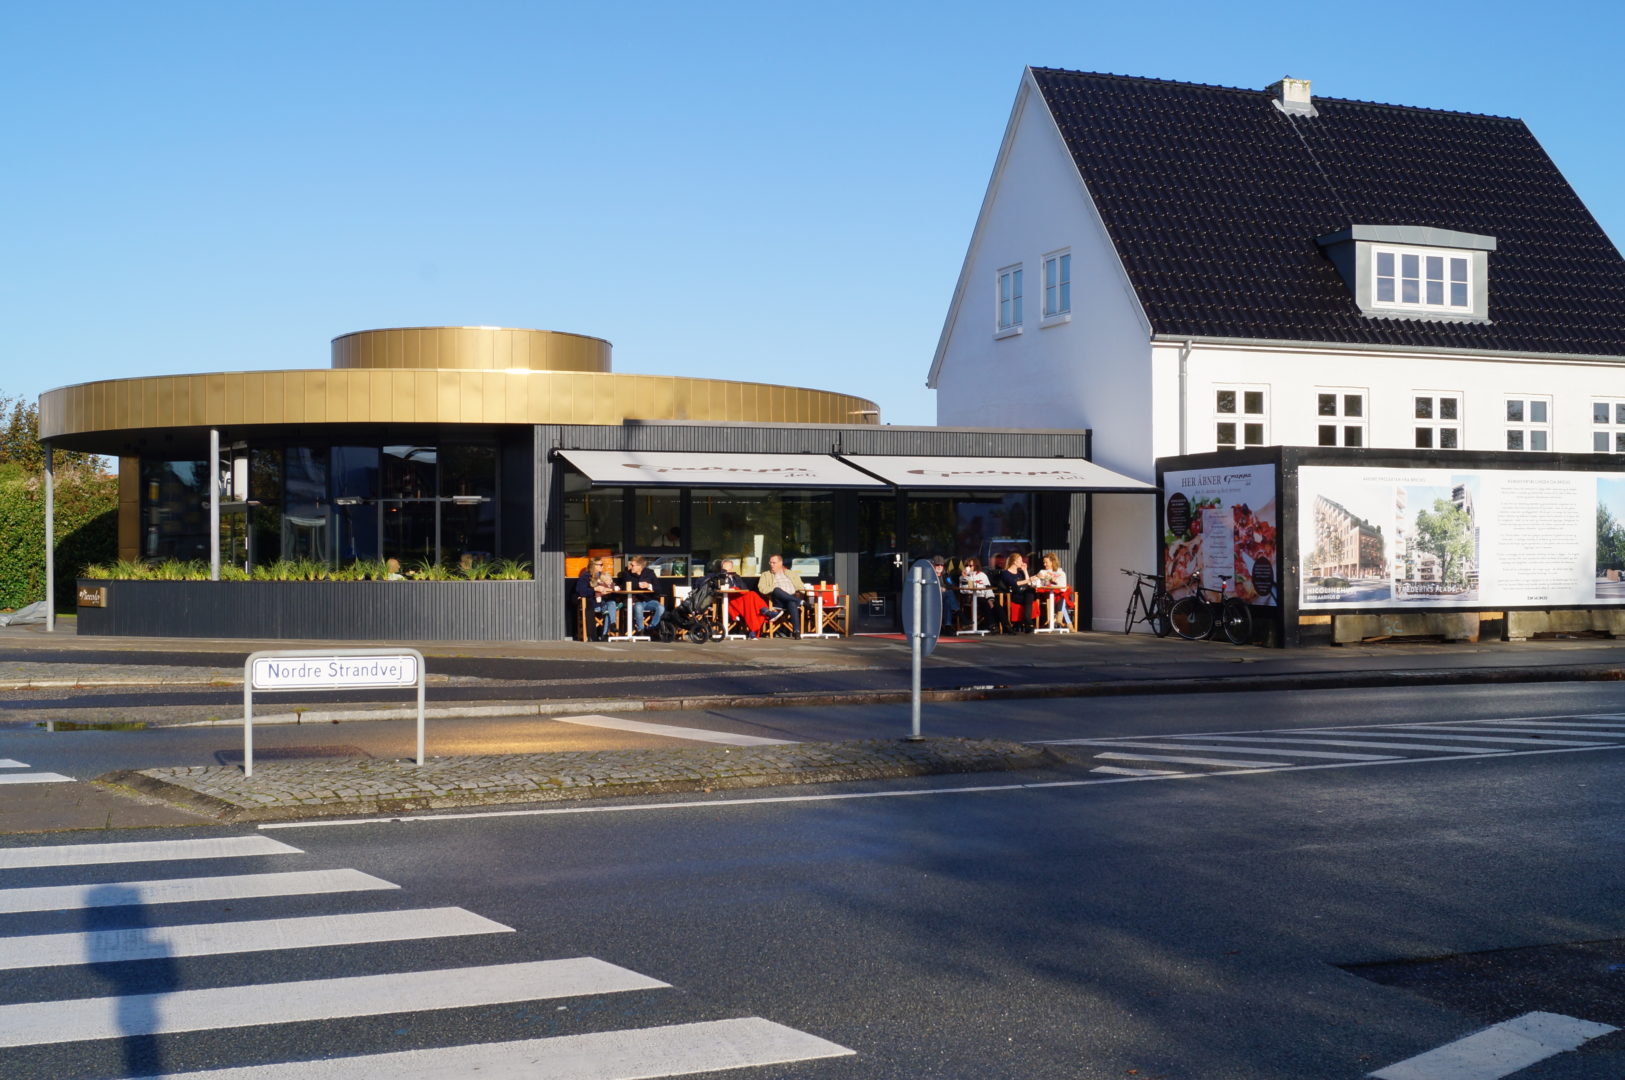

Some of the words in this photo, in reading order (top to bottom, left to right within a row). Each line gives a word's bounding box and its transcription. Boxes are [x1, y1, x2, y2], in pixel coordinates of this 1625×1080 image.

[1181, 477, 1196, 487] HER
[1197, 474, 1221, 486] ÅBNER
[268, 663, 322, 679] Nordre
[328, 661, 403, 680] Strandvej
